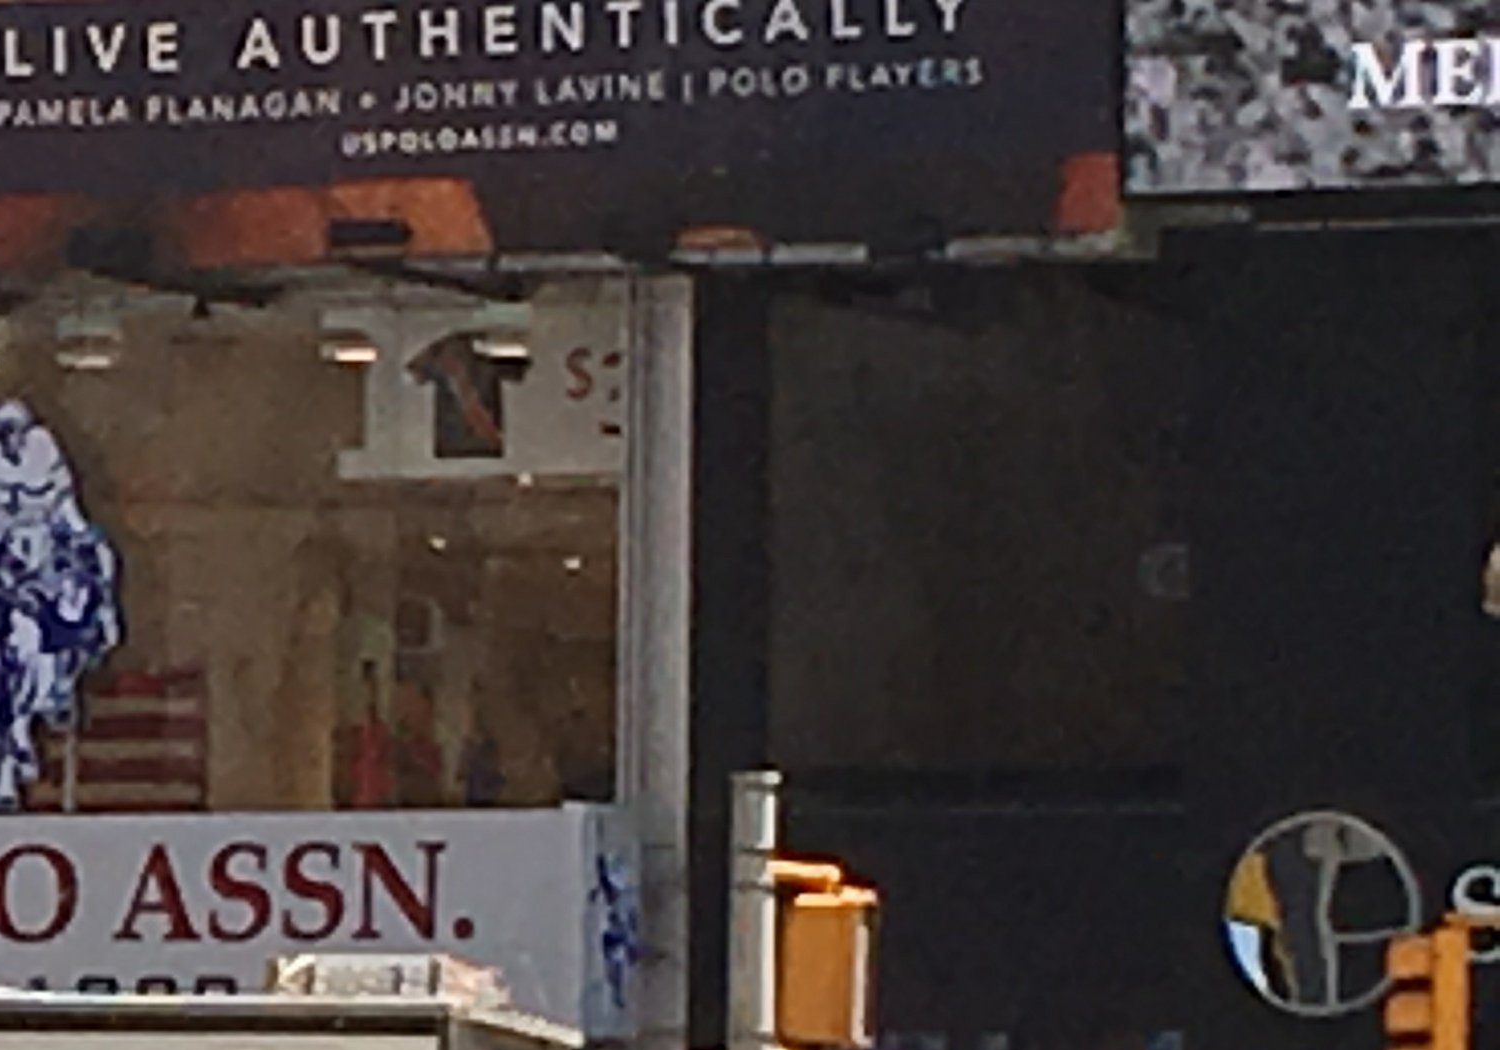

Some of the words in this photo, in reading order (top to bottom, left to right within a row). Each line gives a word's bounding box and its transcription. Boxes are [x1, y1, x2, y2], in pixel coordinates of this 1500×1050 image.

[4, 22, 180, 77] LIVE
[236, 0, 964, 69] AUTHENTICALLY
[1348, 38, 1500, 109] ME
[145, 90, 341, 124] FLANAGAN
[535, 70, 666, 107] LAVINE
[708, 65, 810, 98] POLO
[825, 57, 984, 92] PLAYERS
[114, 840, 475, 942] ASSN.
